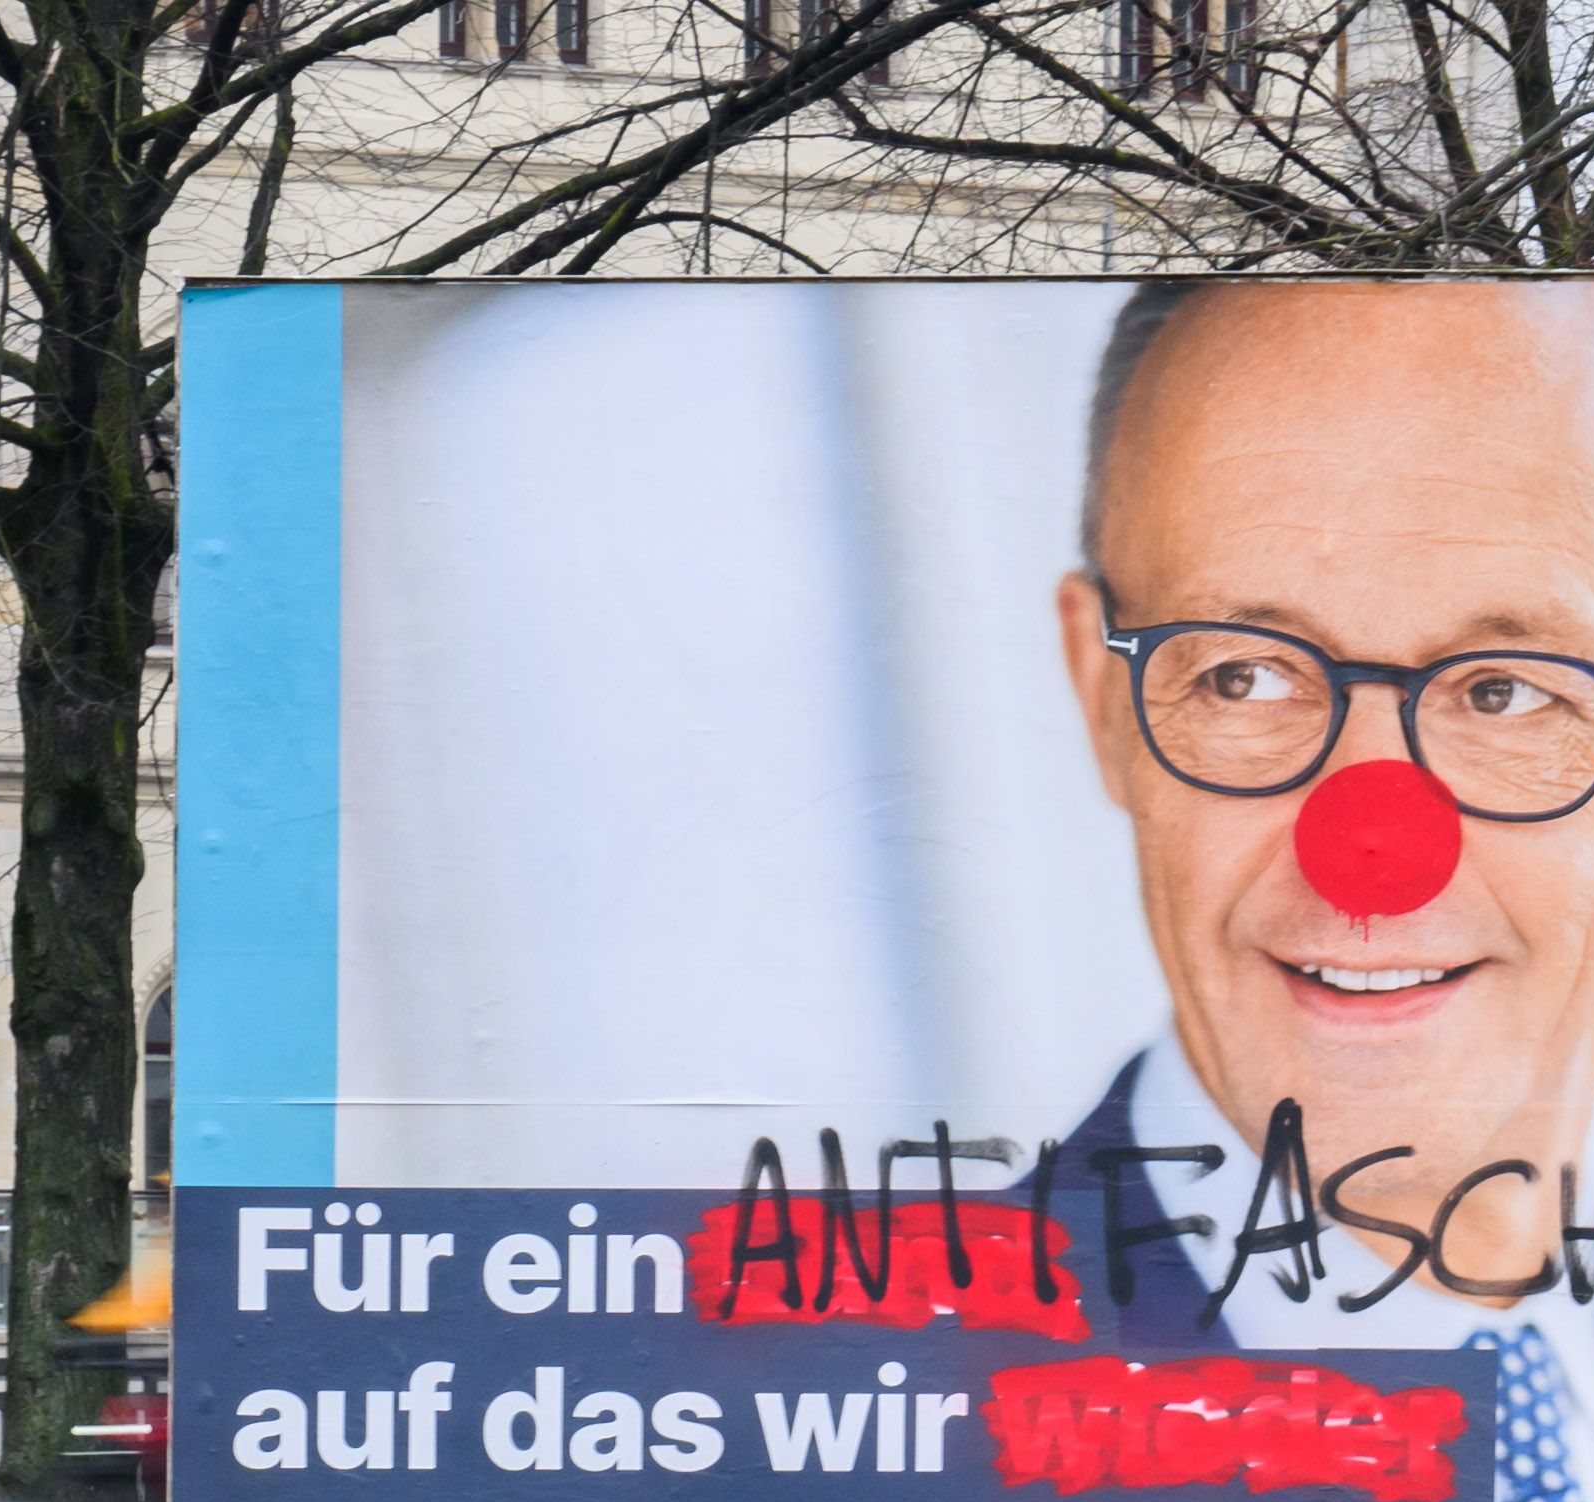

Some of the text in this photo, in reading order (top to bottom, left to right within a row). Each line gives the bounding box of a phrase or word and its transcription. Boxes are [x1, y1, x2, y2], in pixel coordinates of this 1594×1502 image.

[238, 1202, 454, 1313] Für
[483, 1202, 686, 1314] ein
[233, 1360, 455, 1471] auf
[483, 1366, 725, 1473] das
[754, 1360, 969, 1473] wir
